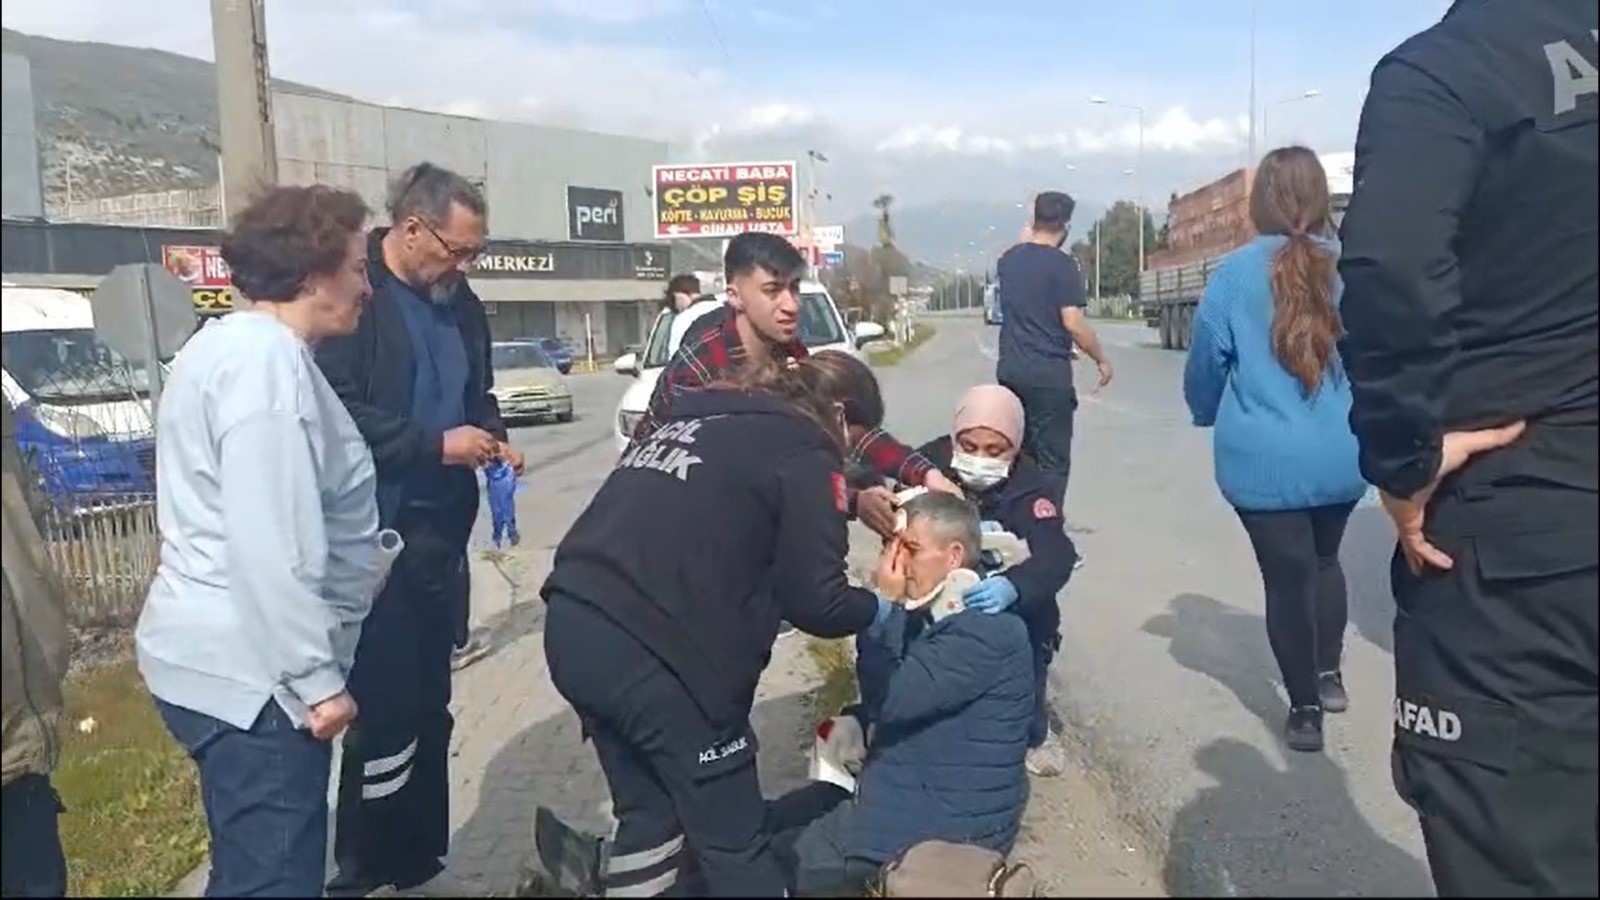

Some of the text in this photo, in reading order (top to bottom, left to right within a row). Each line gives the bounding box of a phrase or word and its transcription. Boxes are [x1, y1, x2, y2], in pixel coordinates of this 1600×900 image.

[661, 167, 789, 182] NECATİ BABA
[664, 182, 786, 207] ÇÖP ŞİŞ
[576, 199, 617, 236] peri
[477, 253, 554, 272] MERKEZİ
